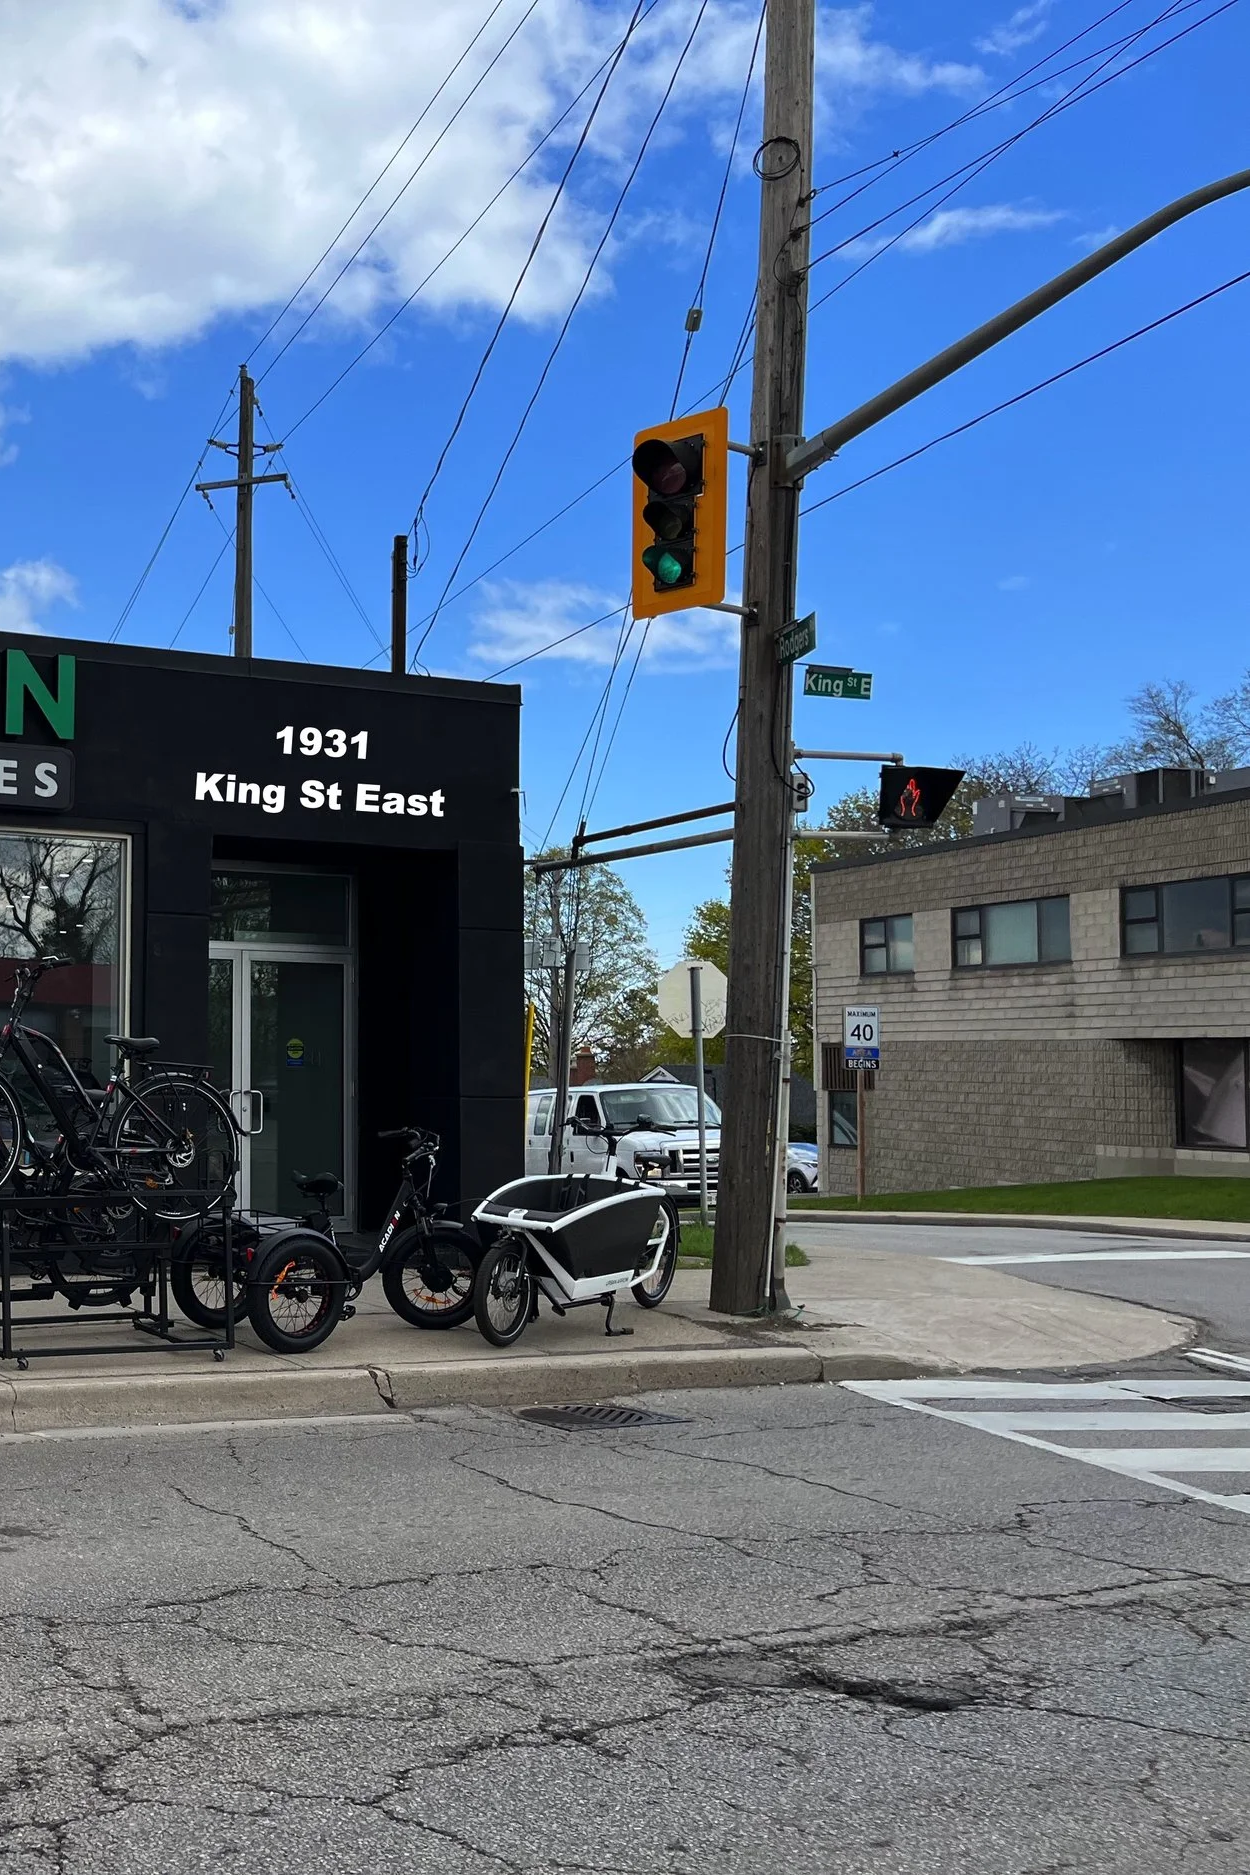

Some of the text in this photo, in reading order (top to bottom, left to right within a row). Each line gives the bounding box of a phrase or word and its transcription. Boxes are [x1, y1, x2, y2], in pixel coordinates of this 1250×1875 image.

[780, 628, 809, 659] Rodgers
[805, 673, 871, 697] King St E
[276, 725, 369, 760] 1931
[194, 772, 446, 818] King St East
[850, 1023, 874, 1042] 40
[848, 1059, 877, 1069] BEGINS
